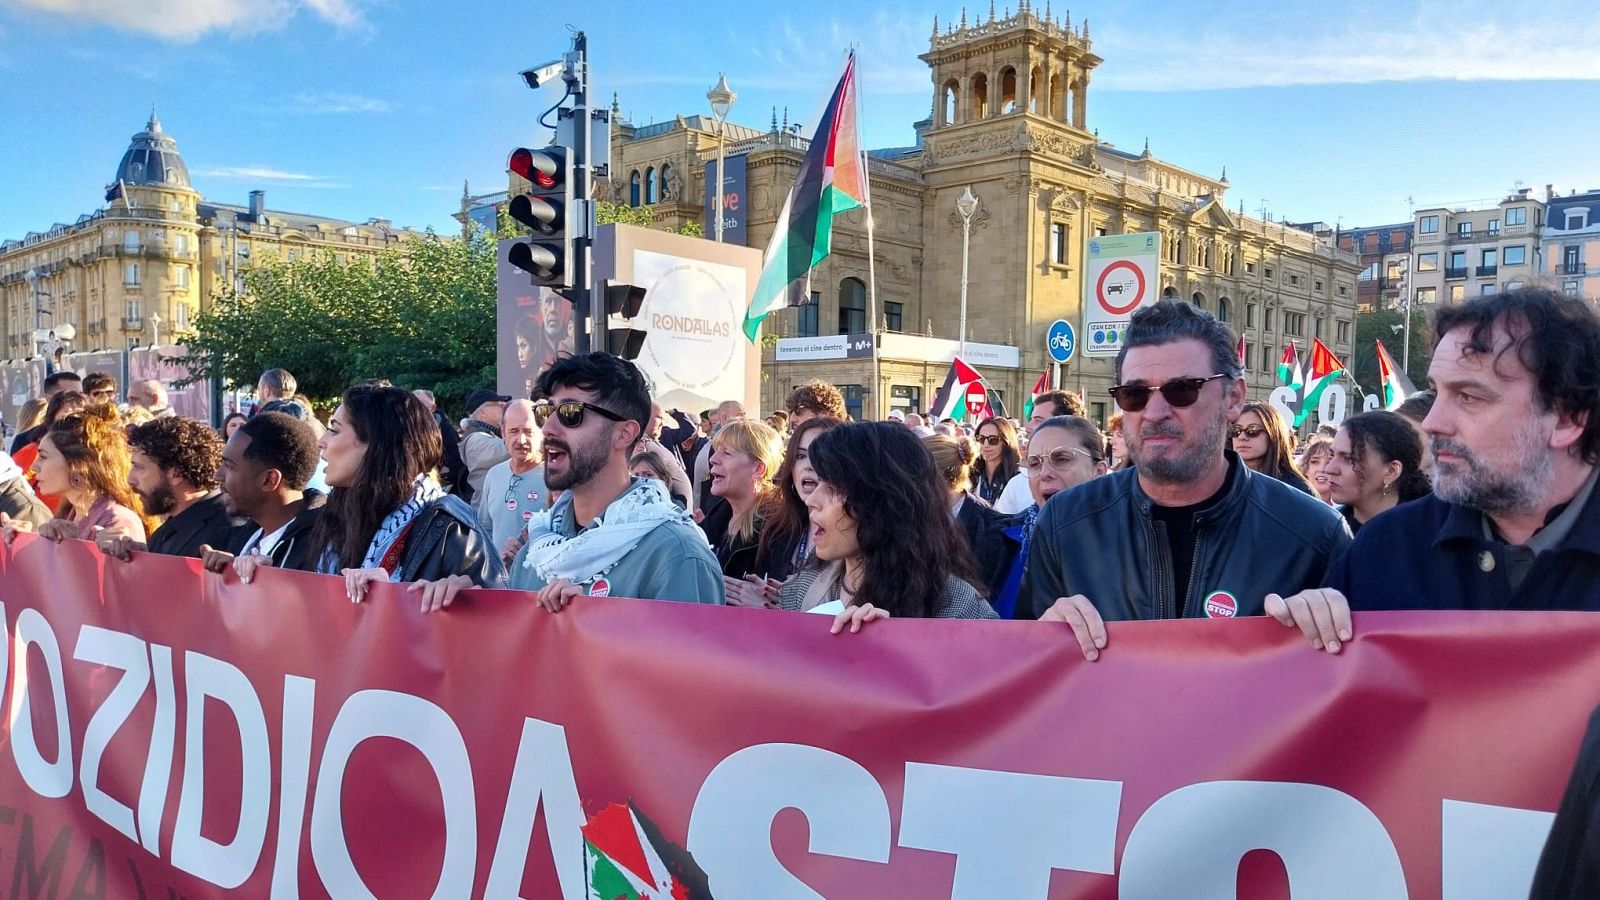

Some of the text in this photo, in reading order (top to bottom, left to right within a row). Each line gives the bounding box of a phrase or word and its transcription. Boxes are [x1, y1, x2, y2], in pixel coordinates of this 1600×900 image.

[652, 313, 730, 337] RONDALLAS
[810, 344, 822, 352] cine
[823, 343, 843, 351] dentro
[1208, 604, 1233, 616] STOP
[0, 601, 1558, 900] OZIDIOA STO
